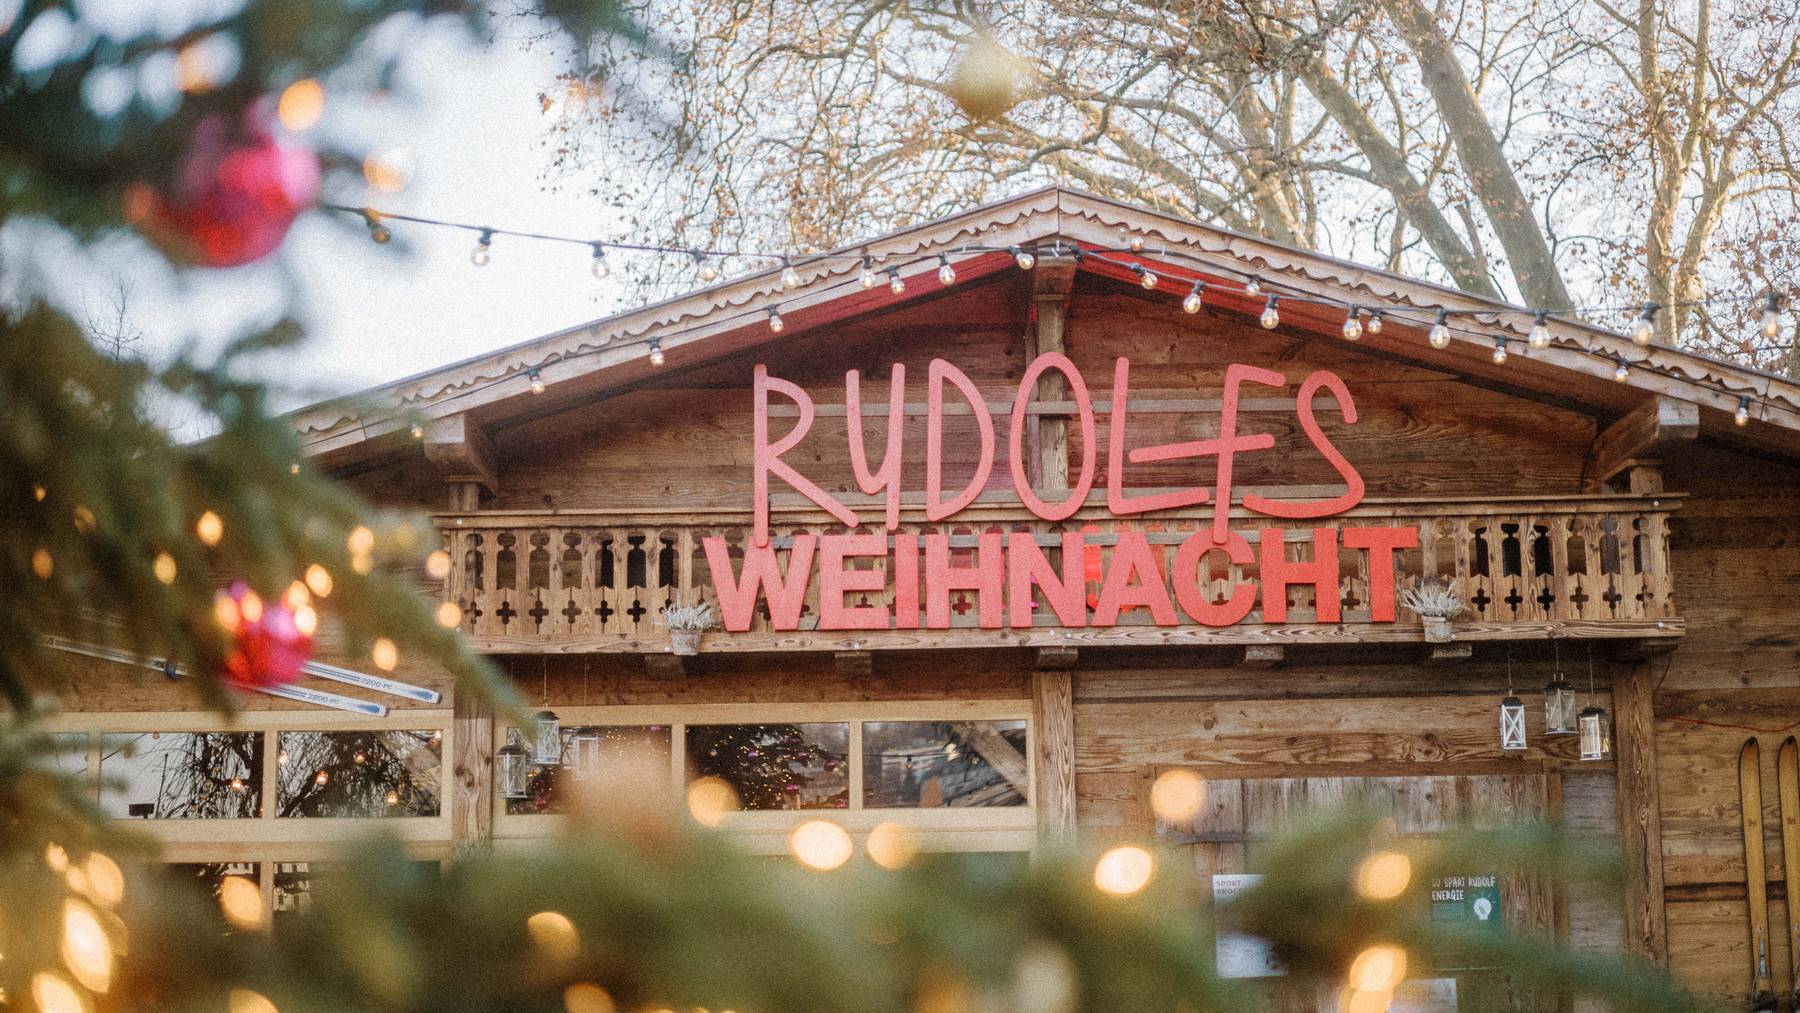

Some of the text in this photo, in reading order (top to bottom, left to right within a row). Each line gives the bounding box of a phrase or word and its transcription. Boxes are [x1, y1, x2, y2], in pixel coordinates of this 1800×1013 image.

[753, 351, 1366, 548] RUDOLFS
[701, 526, 1419, 632] WEIHNACHT
[1216, 879, 1242, 887] SPORT
[1444, 876, 1466, 888] SPART
[1468, 875, 1496, 888] RUDOLF
[1431, 889, 1465, 901] ENERGIE
